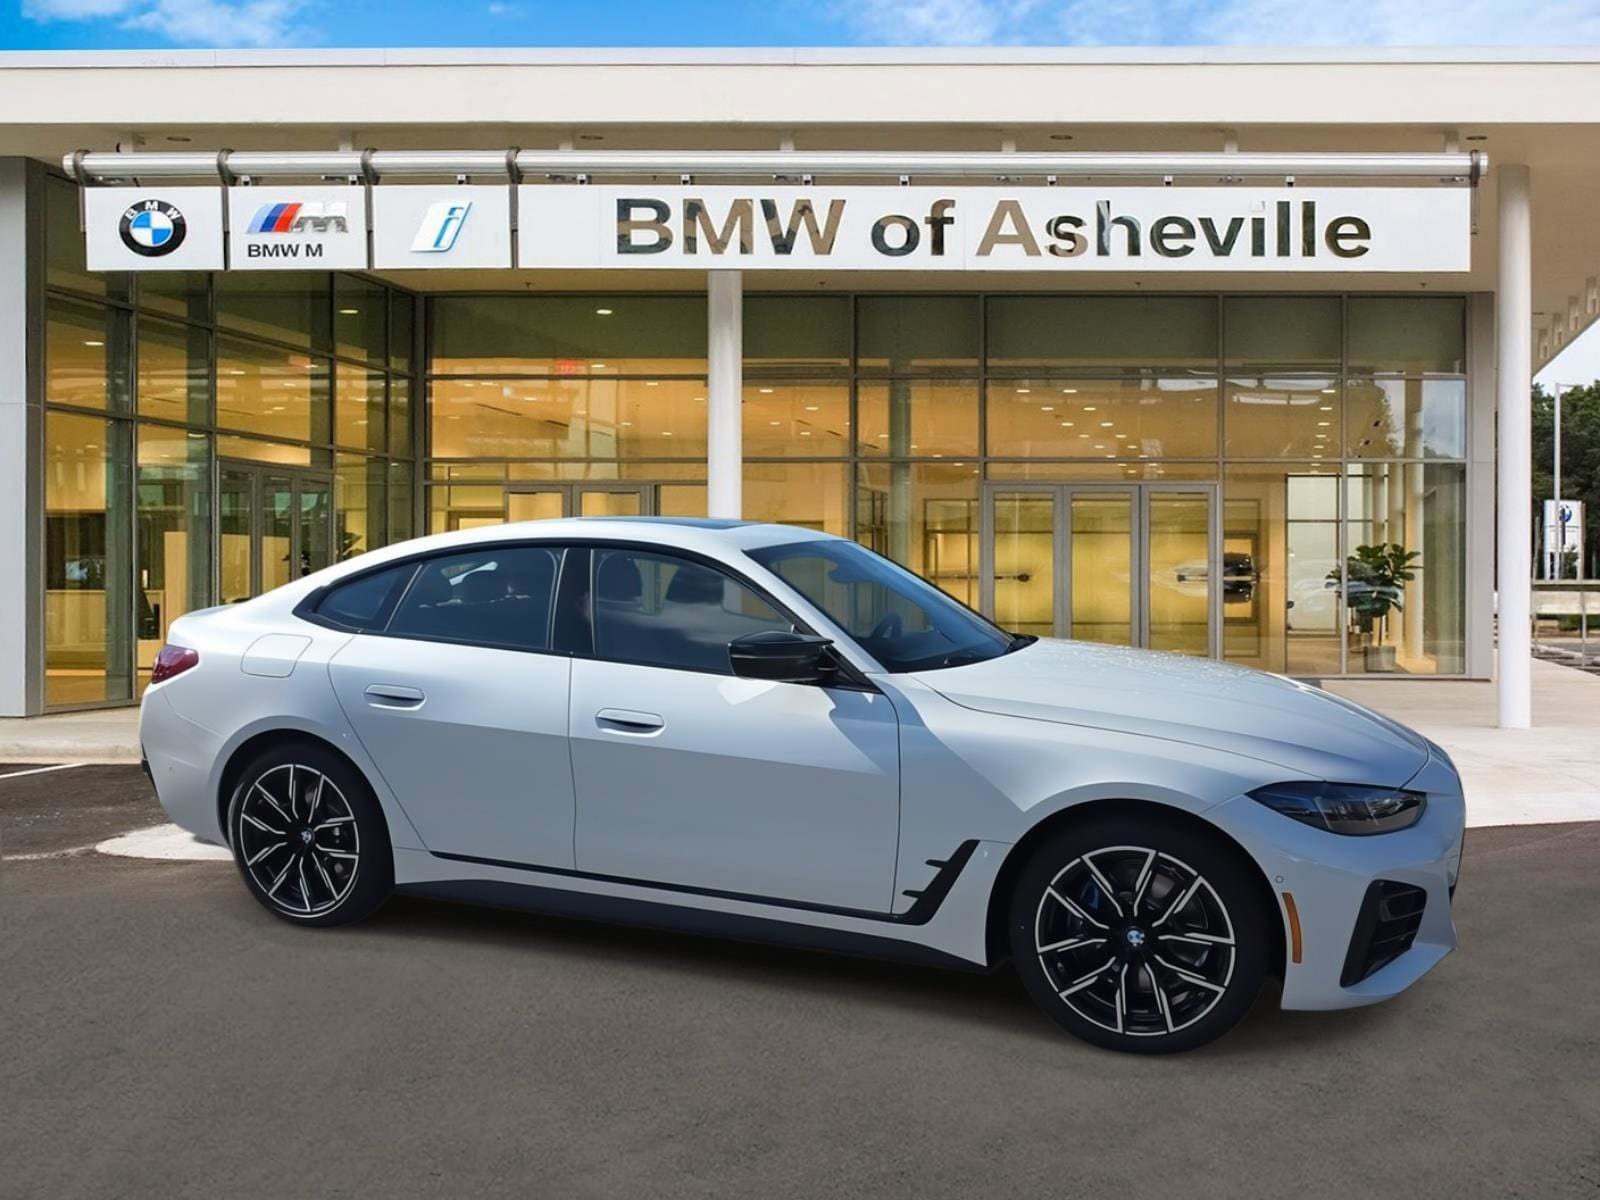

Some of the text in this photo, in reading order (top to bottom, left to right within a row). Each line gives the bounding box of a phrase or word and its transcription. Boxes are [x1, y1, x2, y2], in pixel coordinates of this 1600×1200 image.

[125, 200, 181, 220] BMW
[616, 198, 1372, 257] BMW of Asheville
[247, 243, 323, 258] BMW M
